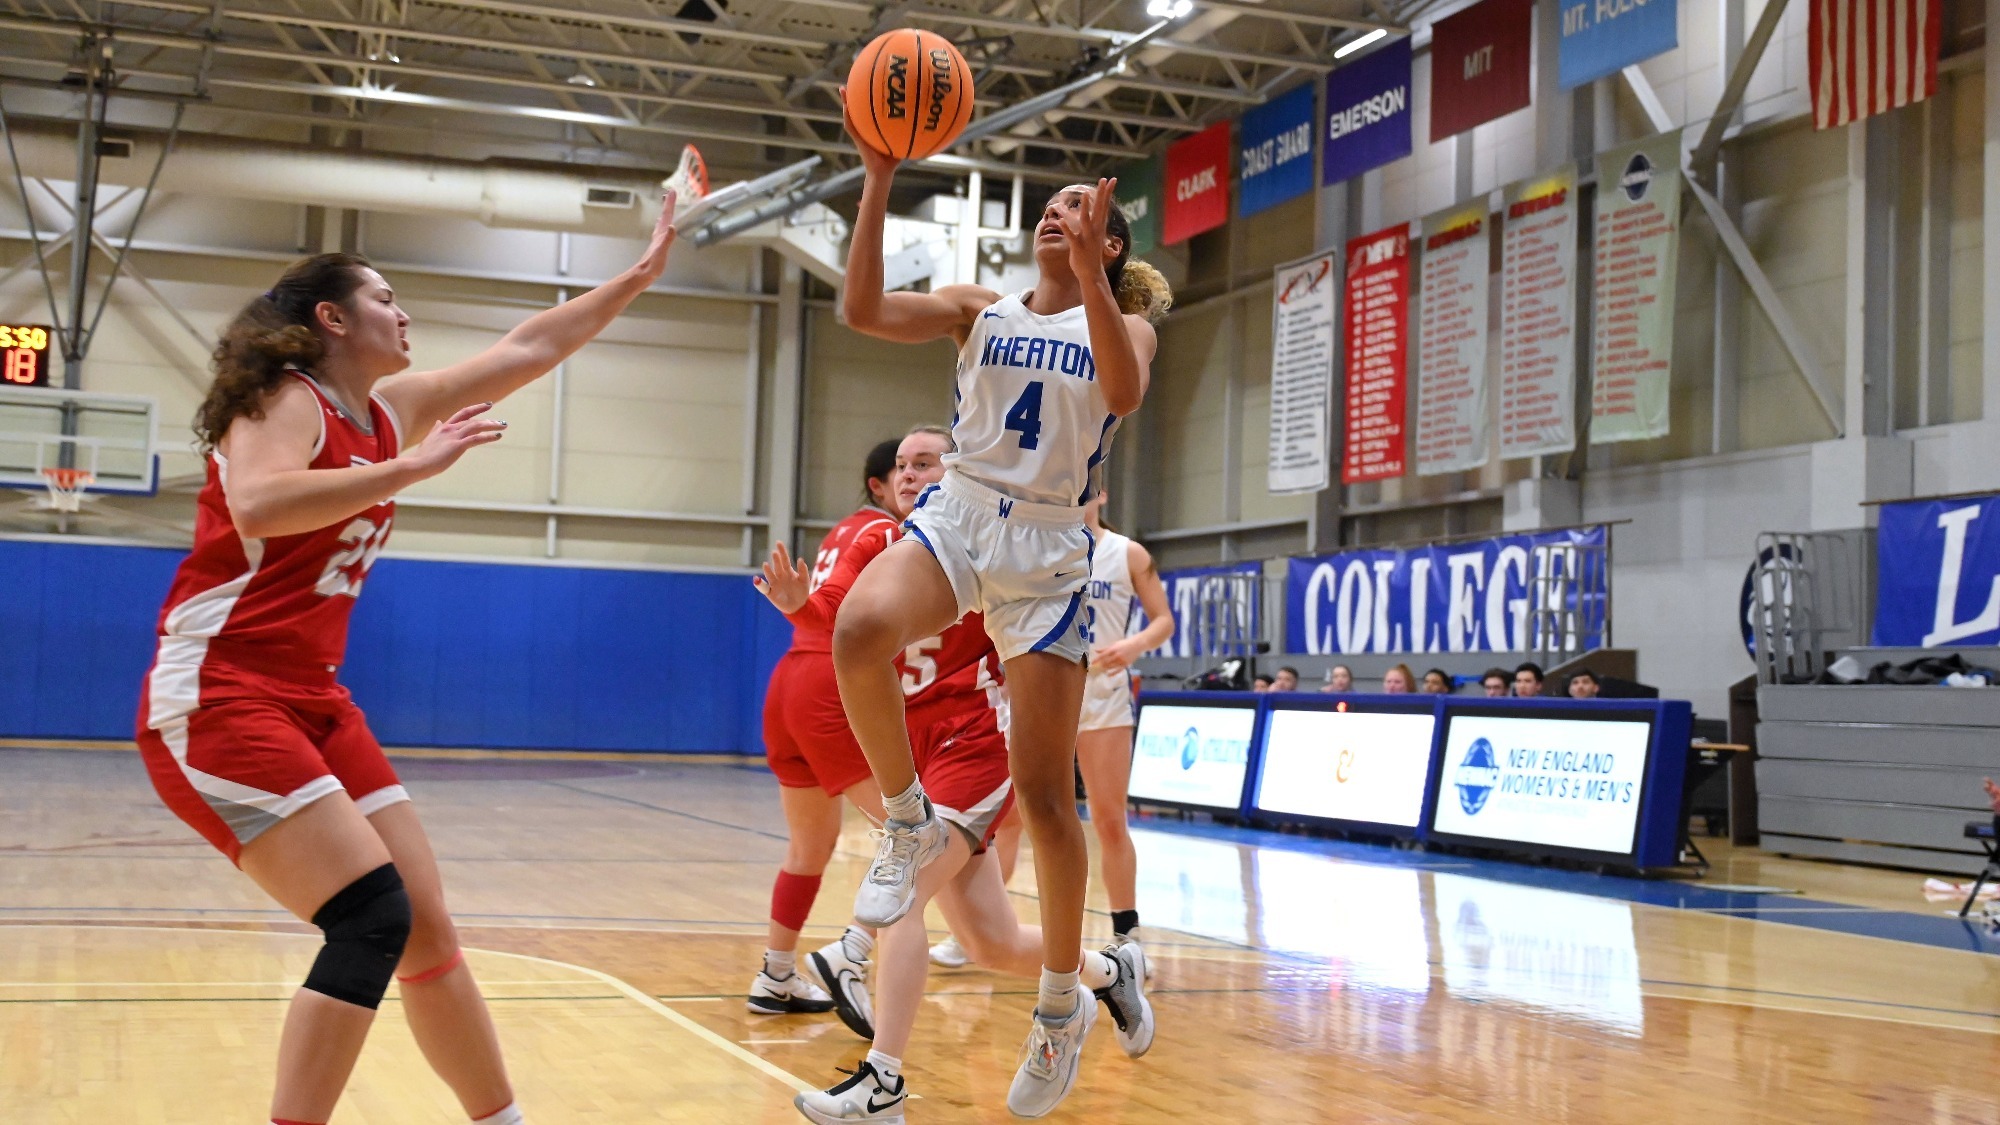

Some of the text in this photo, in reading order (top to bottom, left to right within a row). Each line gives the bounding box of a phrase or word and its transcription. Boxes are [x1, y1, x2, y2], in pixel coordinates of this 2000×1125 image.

[887, 53, 909, 119] NCAA
[923, 47, 952, 132] Wilson
[1463, 45, 1494, 81] MIT
[1330, 85, 1406, 140] EMERSON
[1241, 121, 1310, 180] COAST GUARD
[1176, 165, 1218, 202] CLARK
[5, 348, 37, 383] 18
[1005, 380, 1044, 450] 4
[998, 498, 1014, 519] W
[1304, 541, 1577, 655] COLLEGE
[901, 636, 943, 696] 5
[1501, 774, 1569, 798] WOMEN'S
[1572, 781, 1581, 800] &
[1584, 779, 1633, 803] MEN'S
[1506, 748, 1615, 774] NEW ENGLAND
